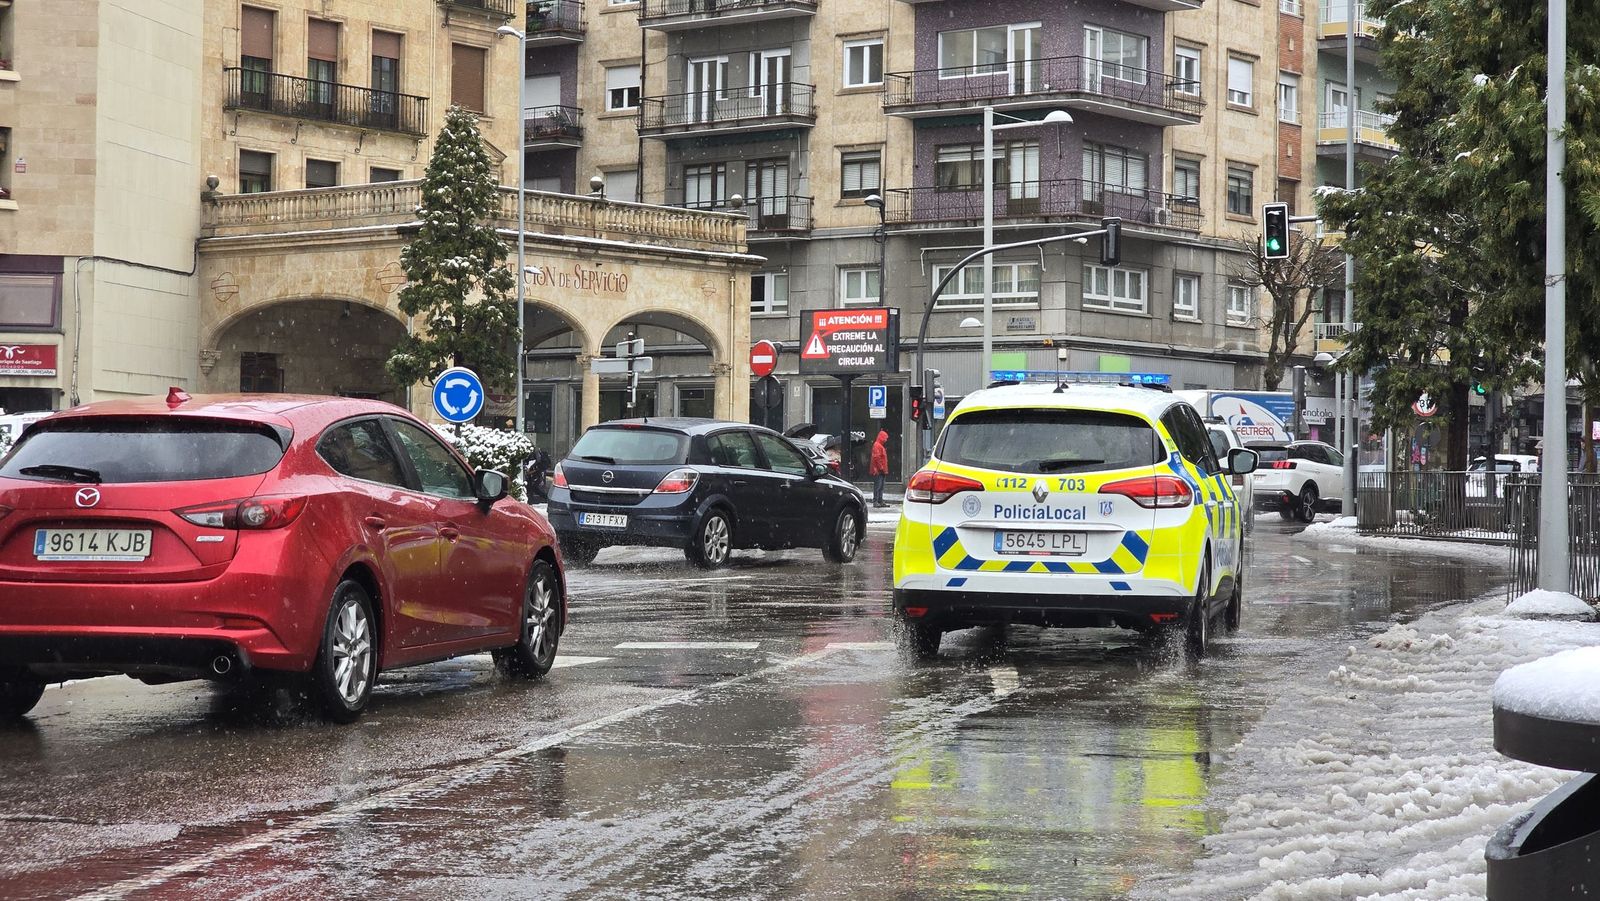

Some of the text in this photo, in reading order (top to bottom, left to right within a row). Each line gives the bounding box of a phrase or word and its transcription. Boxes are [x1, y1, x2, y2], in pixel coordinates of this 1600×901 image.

[559, 273, 571, 288] DE
[828, 314, 872, 325] ATENCIÓN
[832, 332, 877, 341] EXTREME LA
[827, 343, 885, 353] PRECAUCIÓN AL
[838, 357, 875, 366] CIRCULAR
[872, 389, 882, 405] P
[1236, 427, 1274, 436] FELTRERO
[1004, 478, 1085, 491] 112 703
[994, 504, 1086, 520] PolicíaLocal
[585, 514, 625, 526] 6131 FXX
[50, 532, 145, 552] 9614 KJB
[1006, 533, 1081, 549] 5645 LPL
